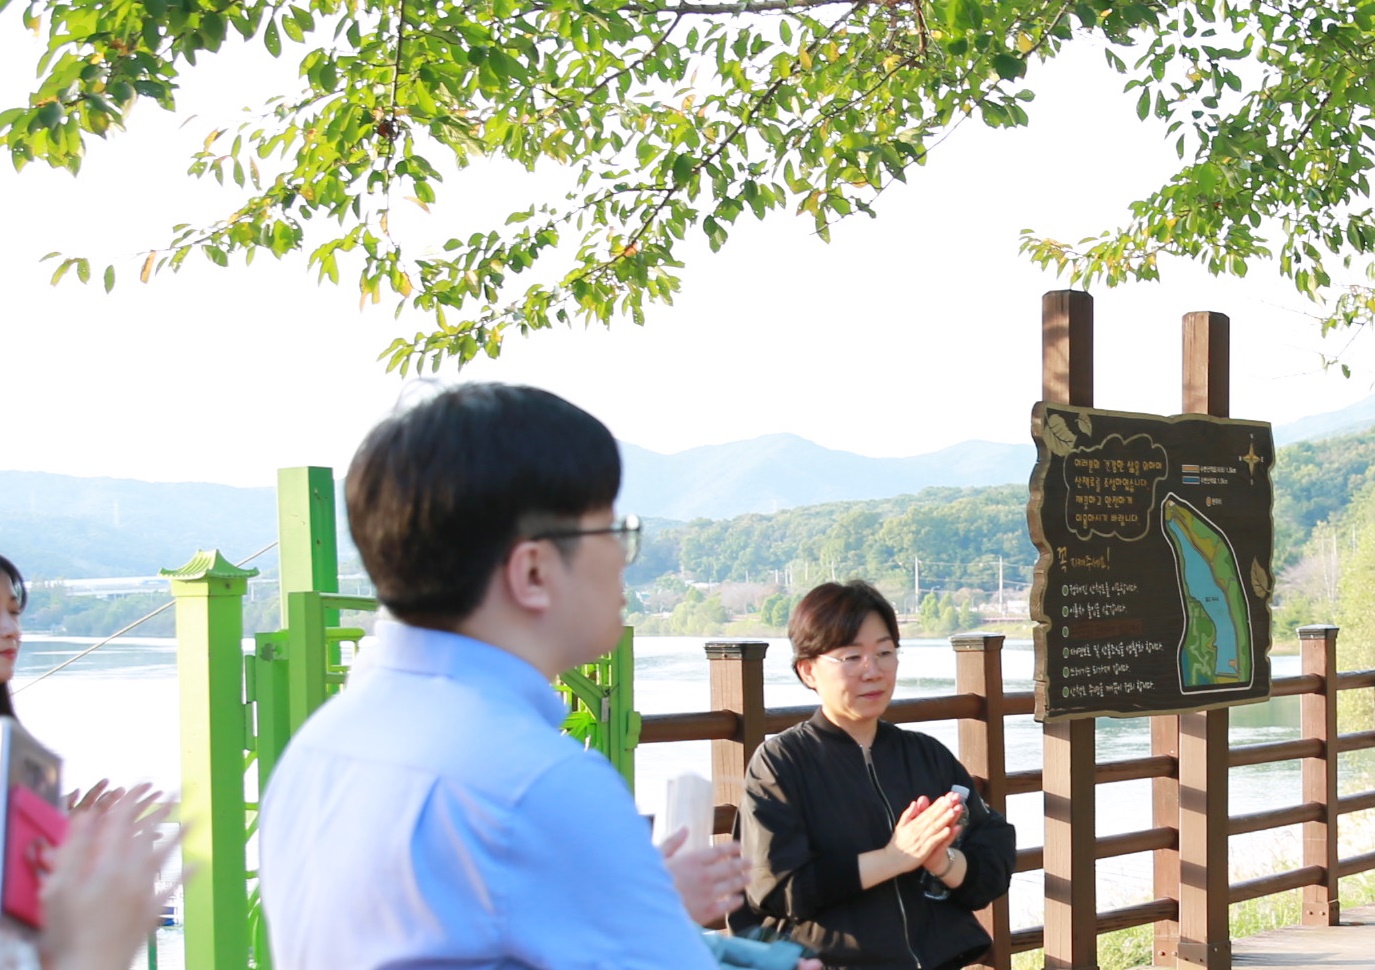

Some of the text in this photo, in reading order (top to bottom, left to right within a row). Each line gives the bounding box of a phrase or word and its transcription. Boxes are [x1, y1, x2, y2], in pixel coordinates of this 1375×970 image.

[1074, 459, 1162, 476] 여러분의 건강한 삶을 위하여
[1075, 477, 1100, 492] 산책로를
[1076, 496, 1133, 510] 깨끗하고 안전하게
[1076, 514, 1107, 528] 이용하시기
[1057, 546, 1110, 573] 꼭 지켜주세요!
[1089, 581, 1110, 597] 산책로를
[1093, 644, 1100, 658] 및
[1070, 666, 1091, 677] 쓰레기는
[1070, 684, 1087, 697] 산책로
